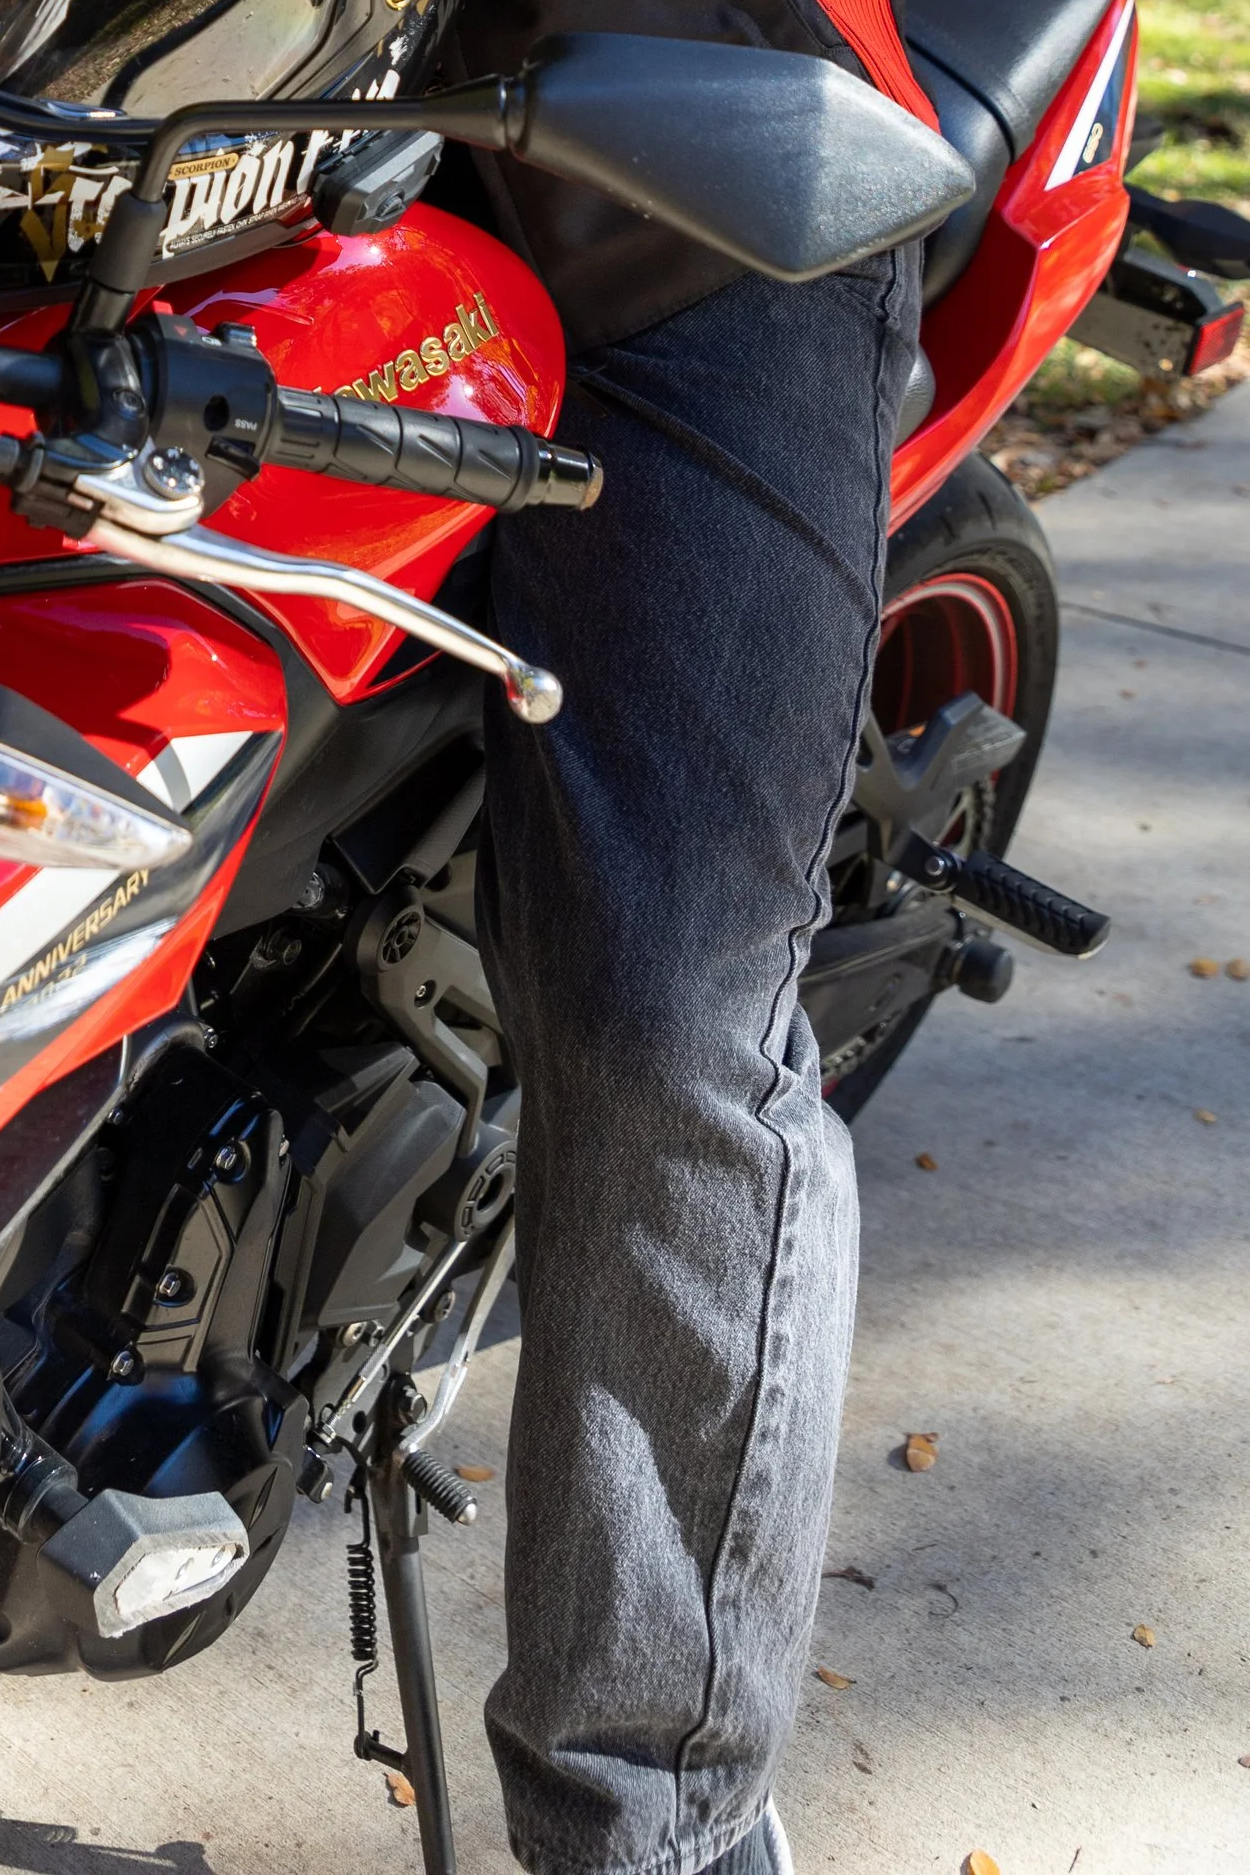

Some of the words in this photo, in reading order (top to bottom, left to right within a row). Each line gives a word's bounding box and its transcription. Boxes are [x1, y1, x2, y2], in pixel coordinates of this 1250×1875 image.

[174, 157, 232, 177] SCORPION
[190, 230, 217, 244] SECURELY
[312, 291, 499, 403] wasaki
[234, 418, 257, 431] PASS
[2, 868, 150, 1006] ANNIVERSARY
